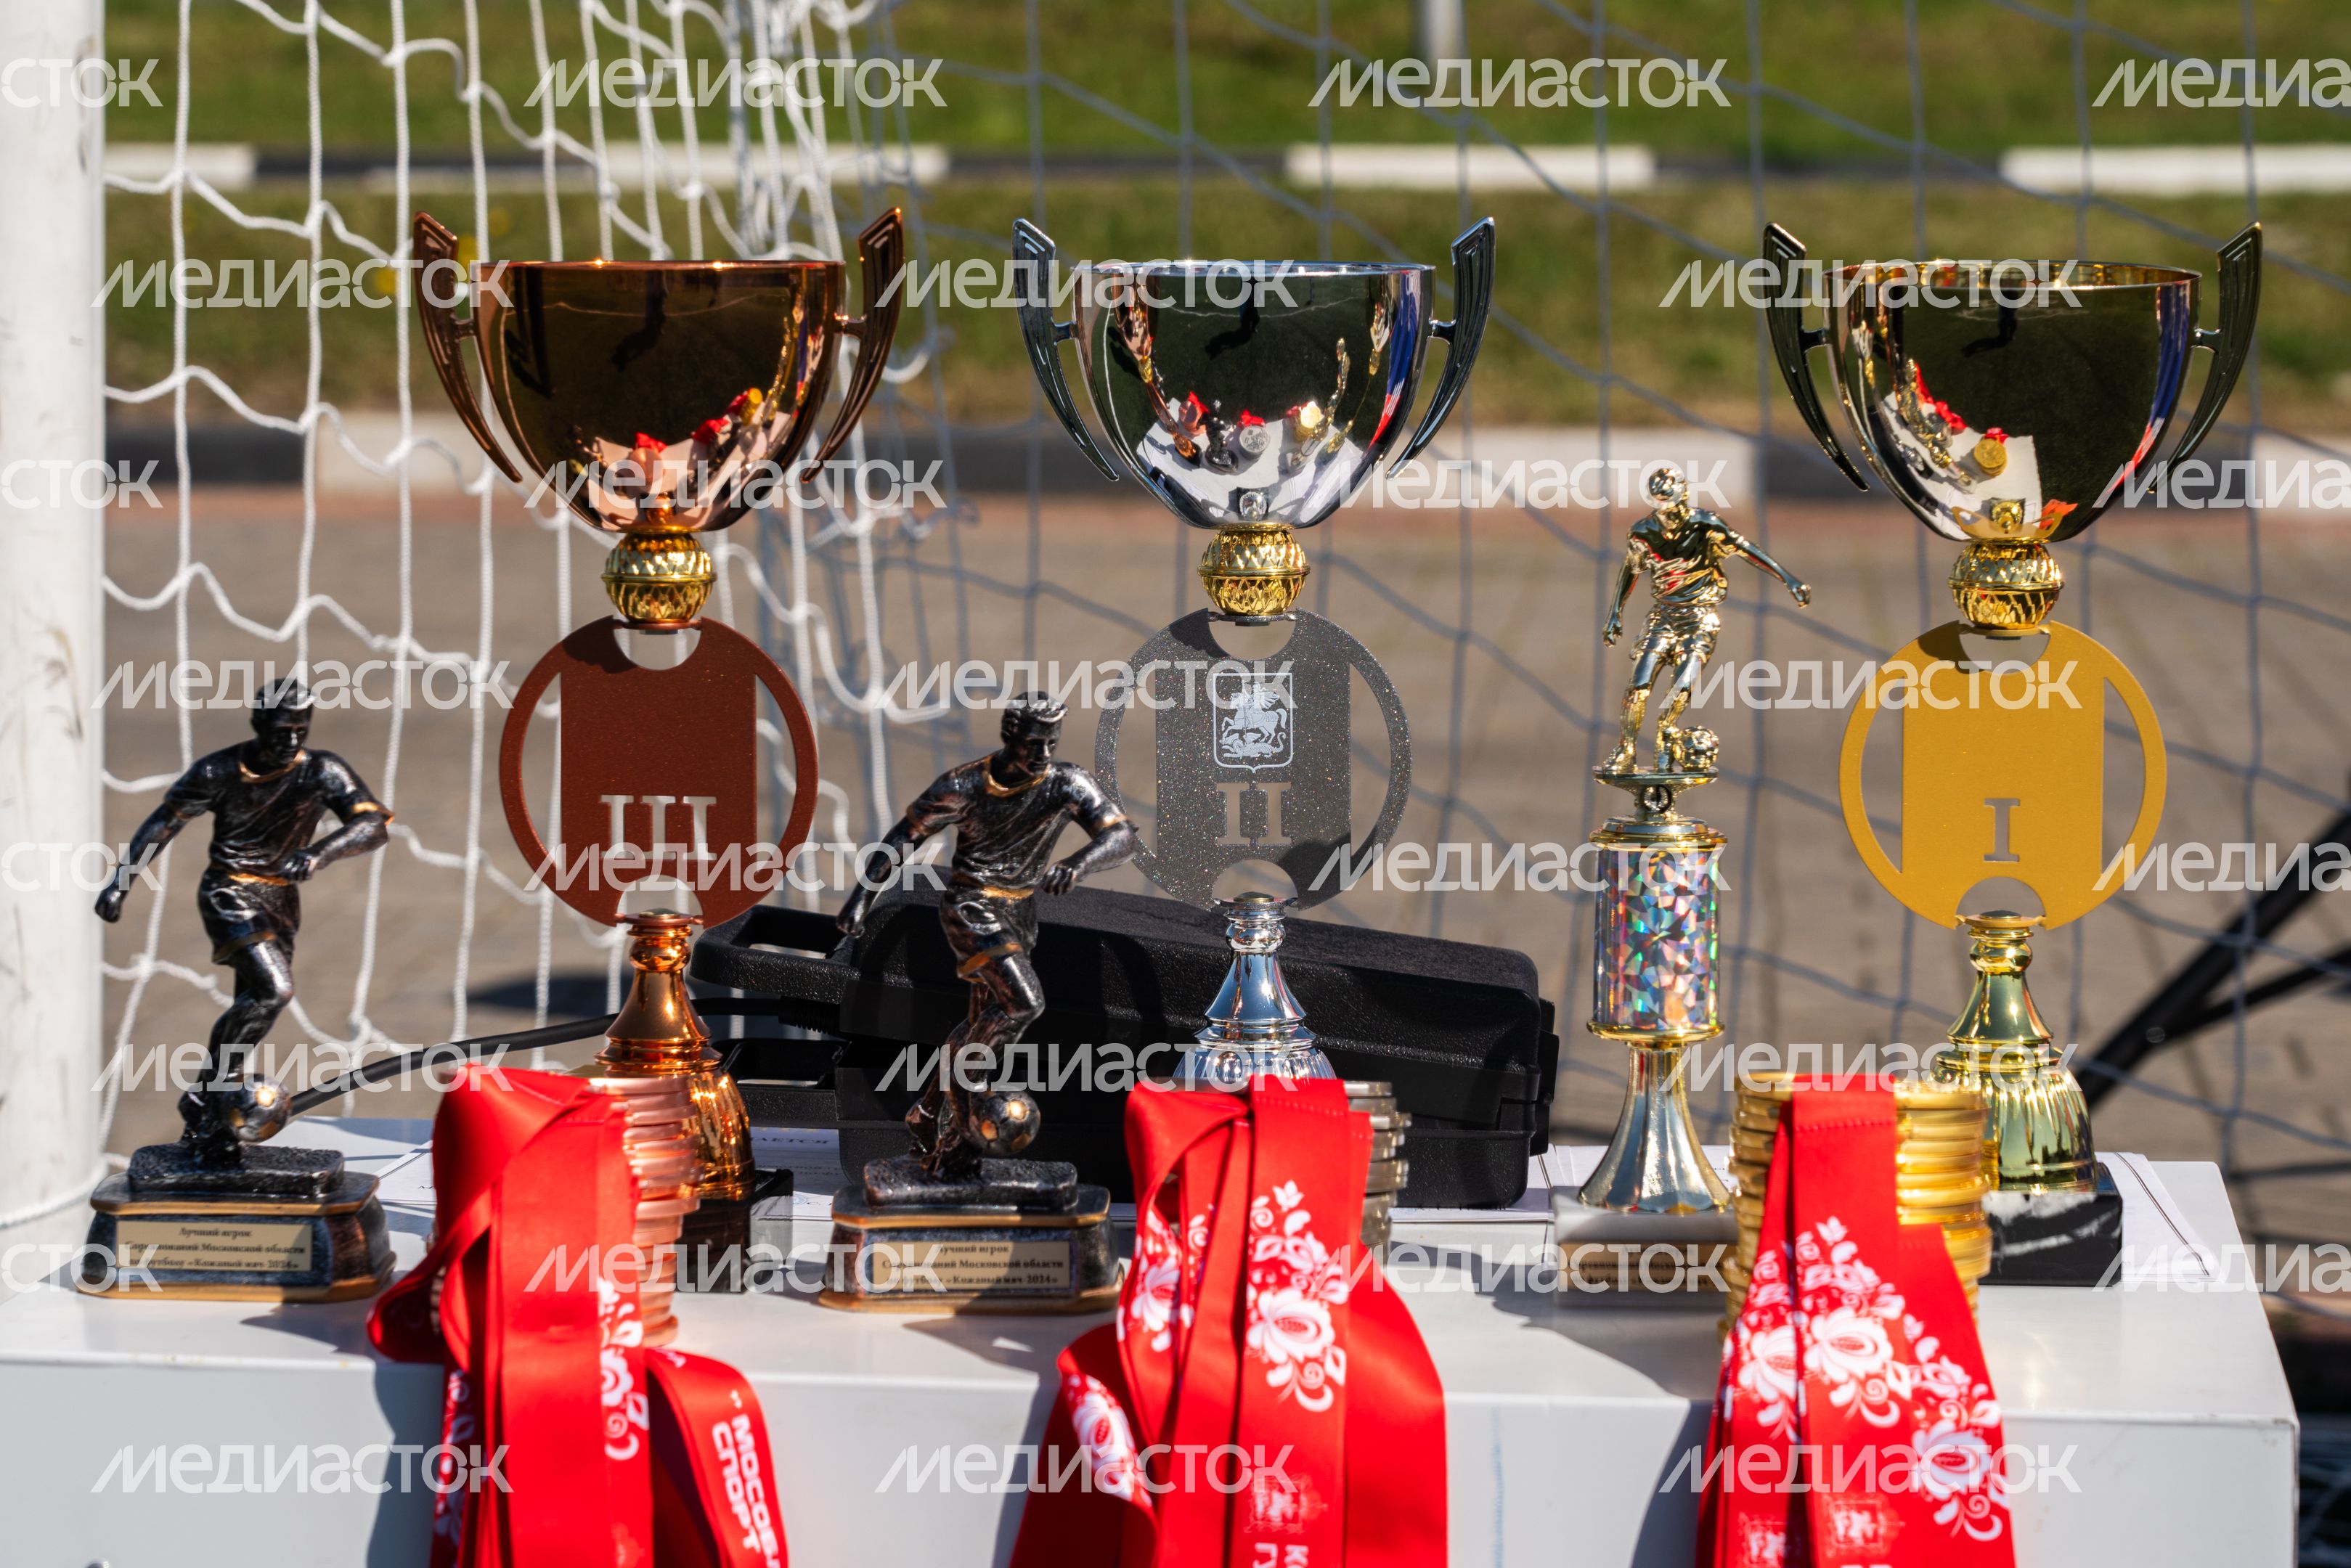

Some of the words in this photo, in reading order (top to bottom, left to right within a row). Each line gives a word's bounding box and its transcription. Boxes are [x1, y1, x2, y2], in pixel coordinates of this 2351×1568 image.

[934, 1244, 977, 1255] учший
[979, 1245, 1009, 1256] игрок
[958, 1259, 1021, 1269] Московской
[1022, 1257, 1064, 1268] области
[712, 1421, 762, 1554] СПОРТ
